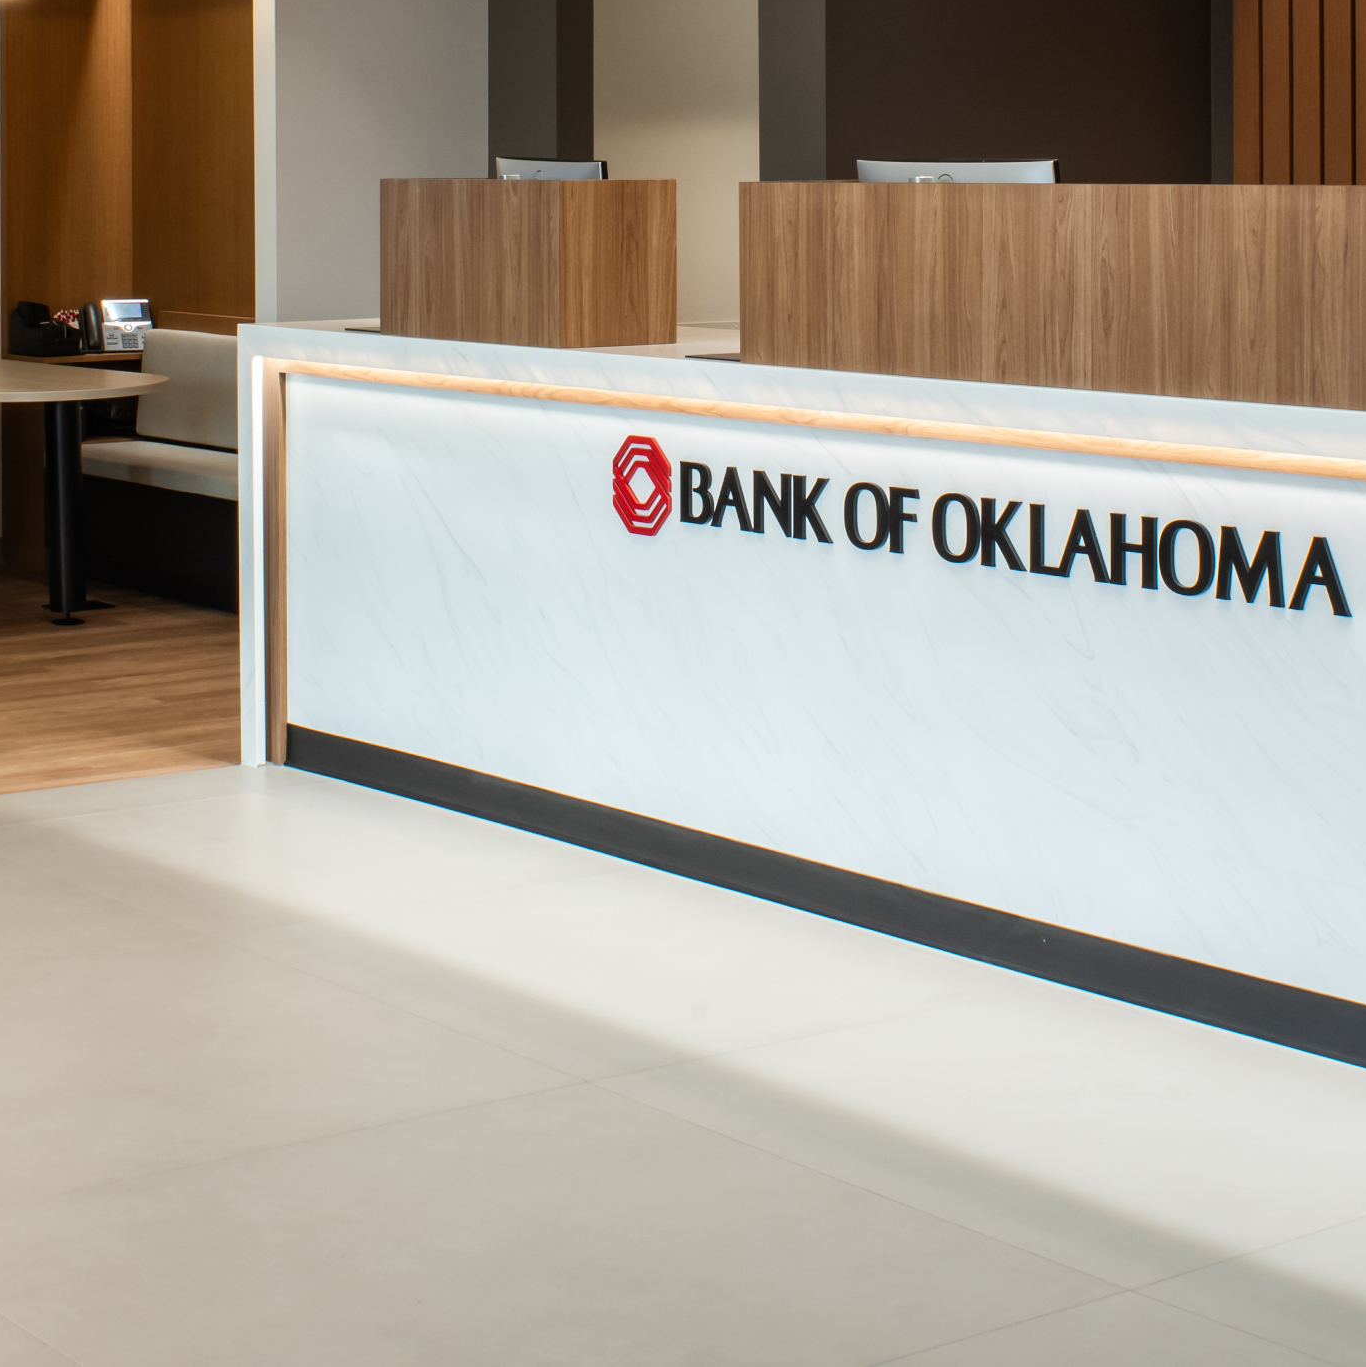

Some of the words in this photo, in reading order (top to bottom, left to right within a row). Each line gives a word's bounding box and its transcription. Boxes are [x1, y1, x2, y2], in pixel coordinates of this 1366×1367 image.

[679, 460, 833, 544] BANK
[843, 481, 920, 554] OF
[931, 492, 1352, 618] OKLAHOMA
